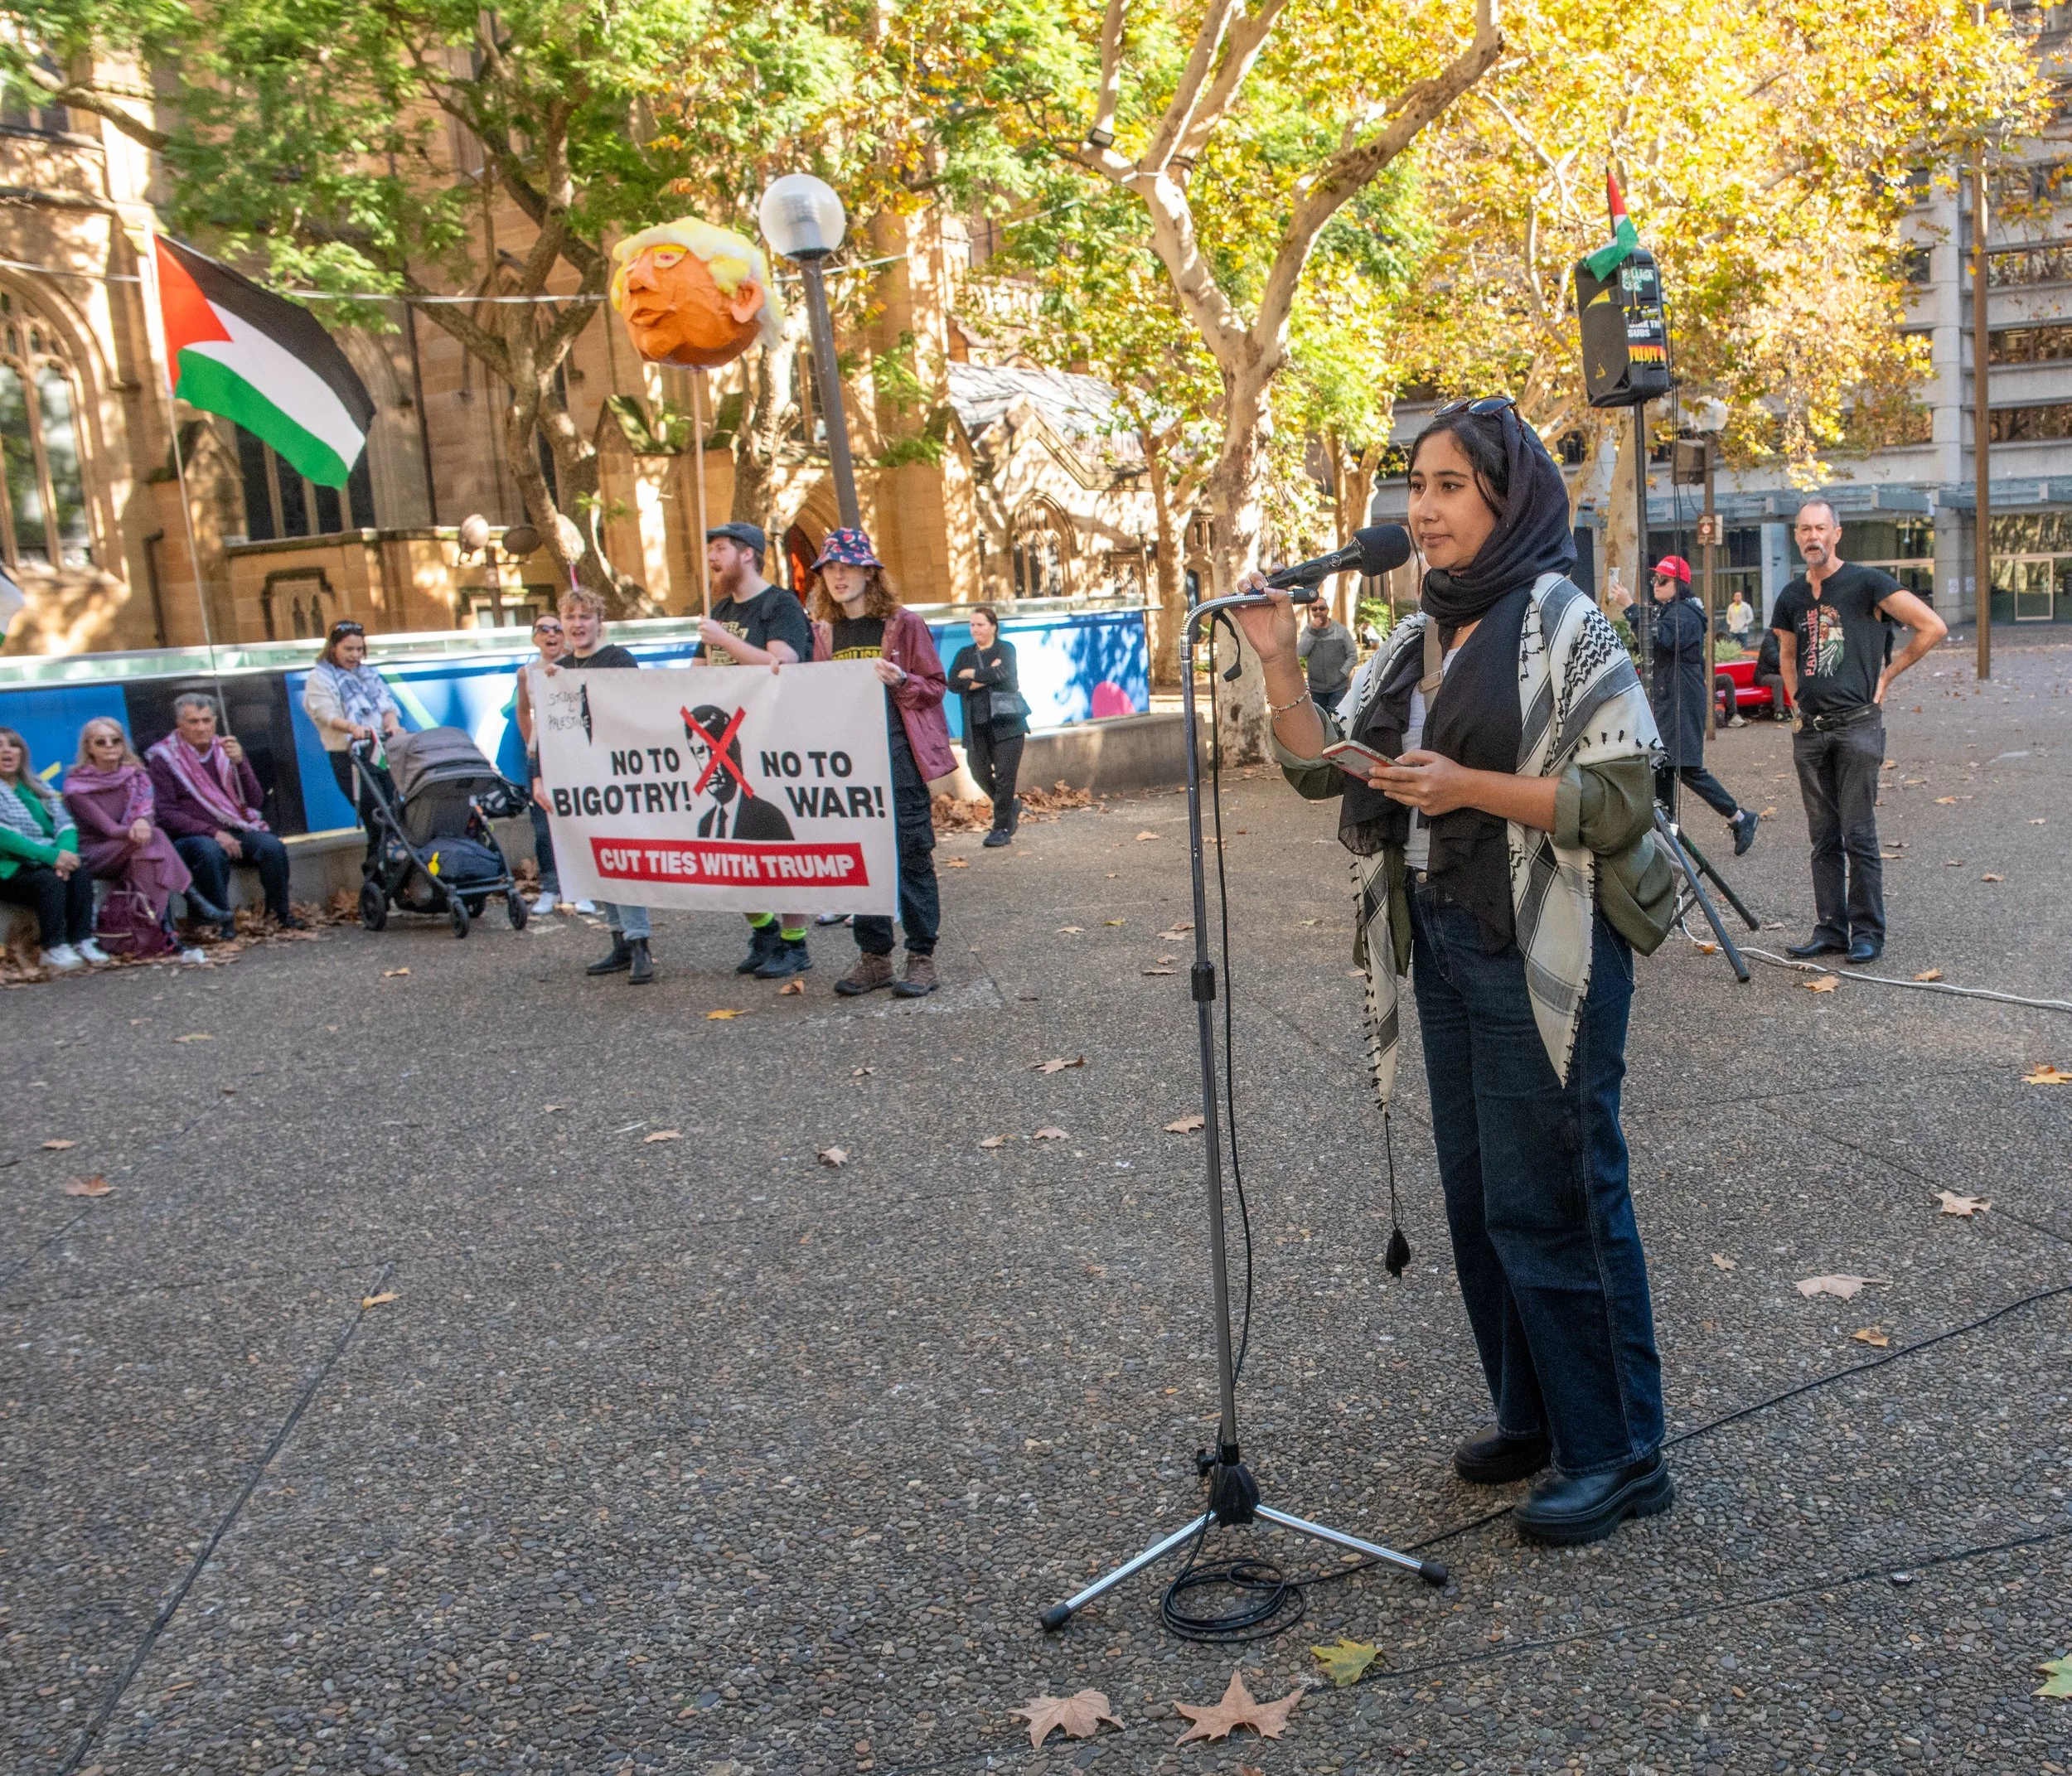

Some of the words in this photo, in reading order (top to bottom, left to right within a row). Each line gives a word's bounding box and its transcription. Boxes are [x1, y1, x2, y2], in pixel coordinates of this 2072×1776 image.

[1627, 328, 1650, 338] SUBS
[1629, 346, 1658, 363] TREATY
[611, 749, 643, 776] NO
[646, 748, 680, 773] TO
[760, 751, 801, 777] NO
[807, 751, 853, 777] TO
[552, 781, 692, 817] BIGOTRY!
[785, 786, 886, 819] WAR!
[599, 848, 641, 872] CUT
[645, 850, 698, 875] TIES
[700, 852, 761, 878] WITH
[759, 854, 855, 878] TRUMP
